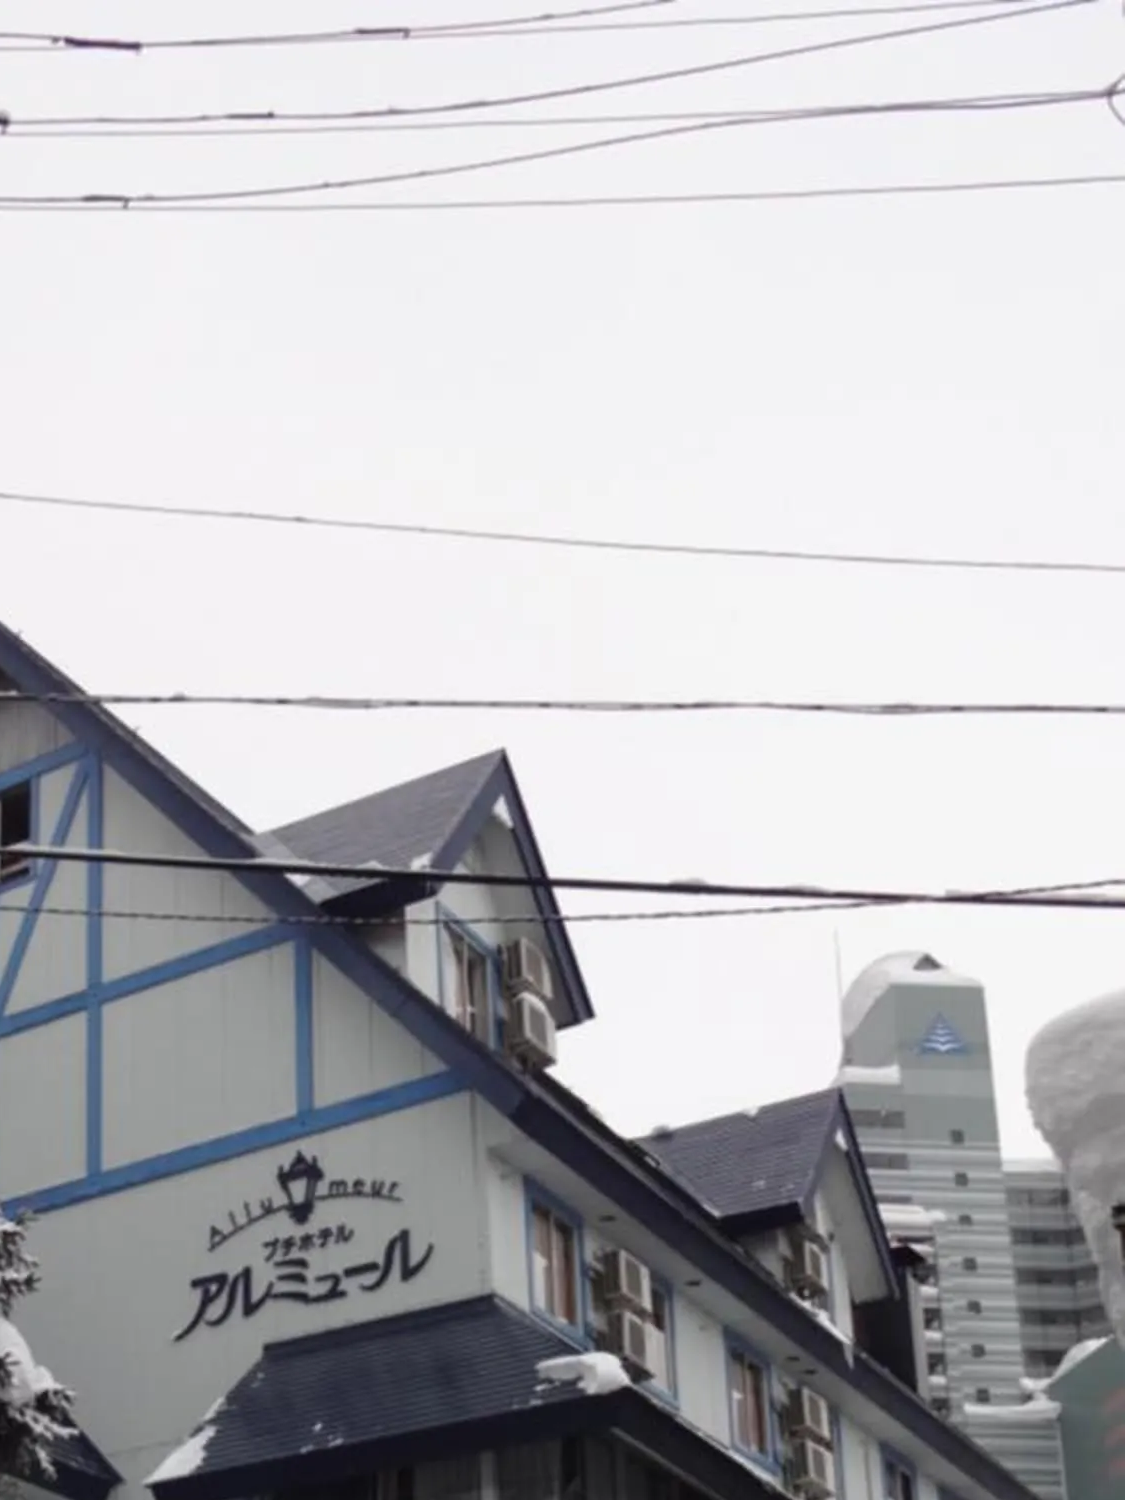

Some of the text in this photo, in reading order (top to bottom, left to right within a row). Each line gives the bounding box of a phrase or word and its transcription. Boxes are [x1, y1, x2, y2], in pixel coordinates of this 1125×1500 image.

[173, 1227, 435, 1342] アルミュール
